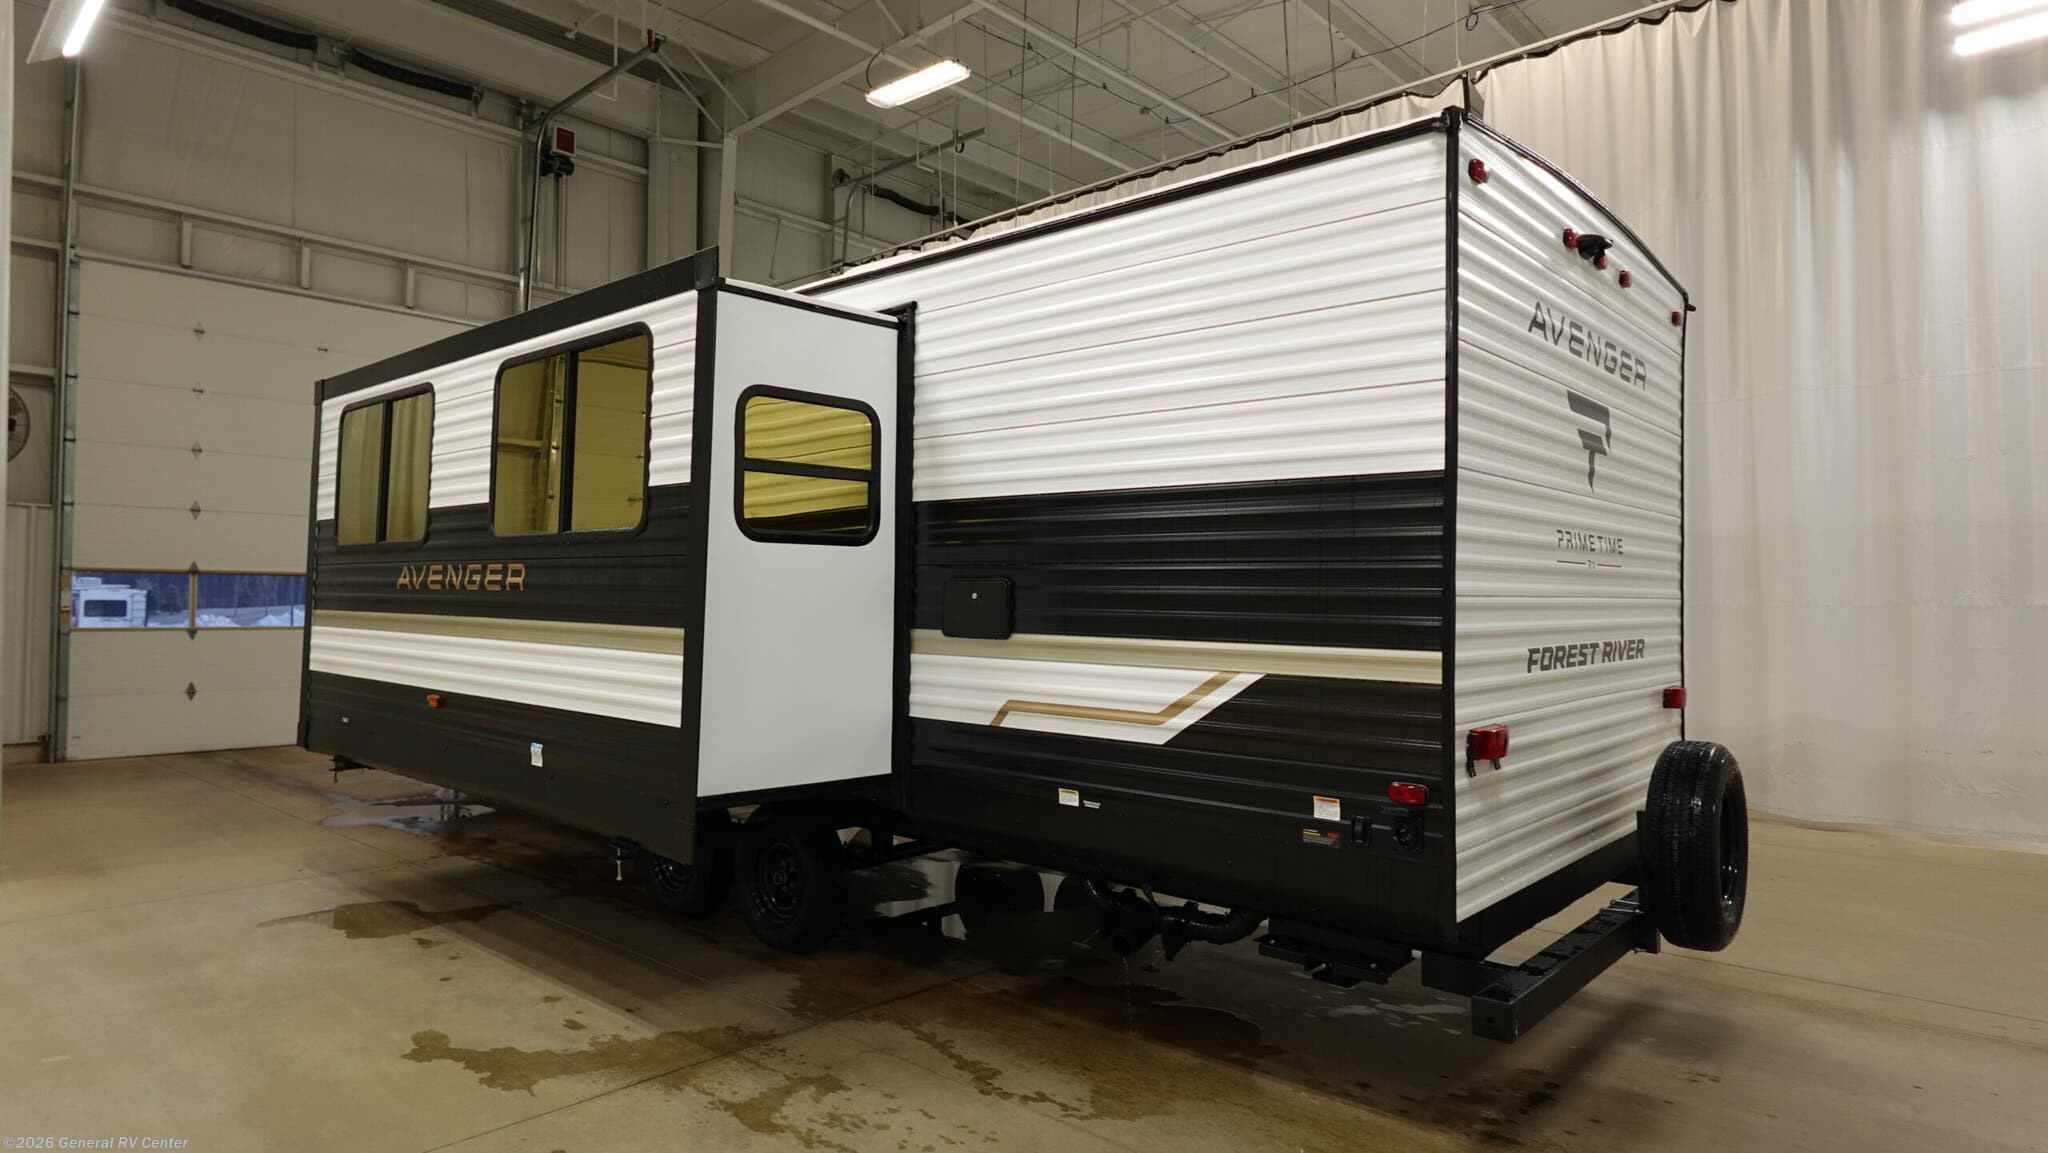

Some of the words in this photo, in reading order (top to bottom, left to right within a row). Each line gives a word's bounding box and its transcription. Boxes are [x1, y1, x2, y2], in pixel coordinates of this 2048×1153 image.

[1528, 301, 1647, 391] AVENGER
[396, 563, 526, 591] AVENGER
[1527, 642, 1600, 673] FOREST
[1601, 638, 1646, 663] RIVER
